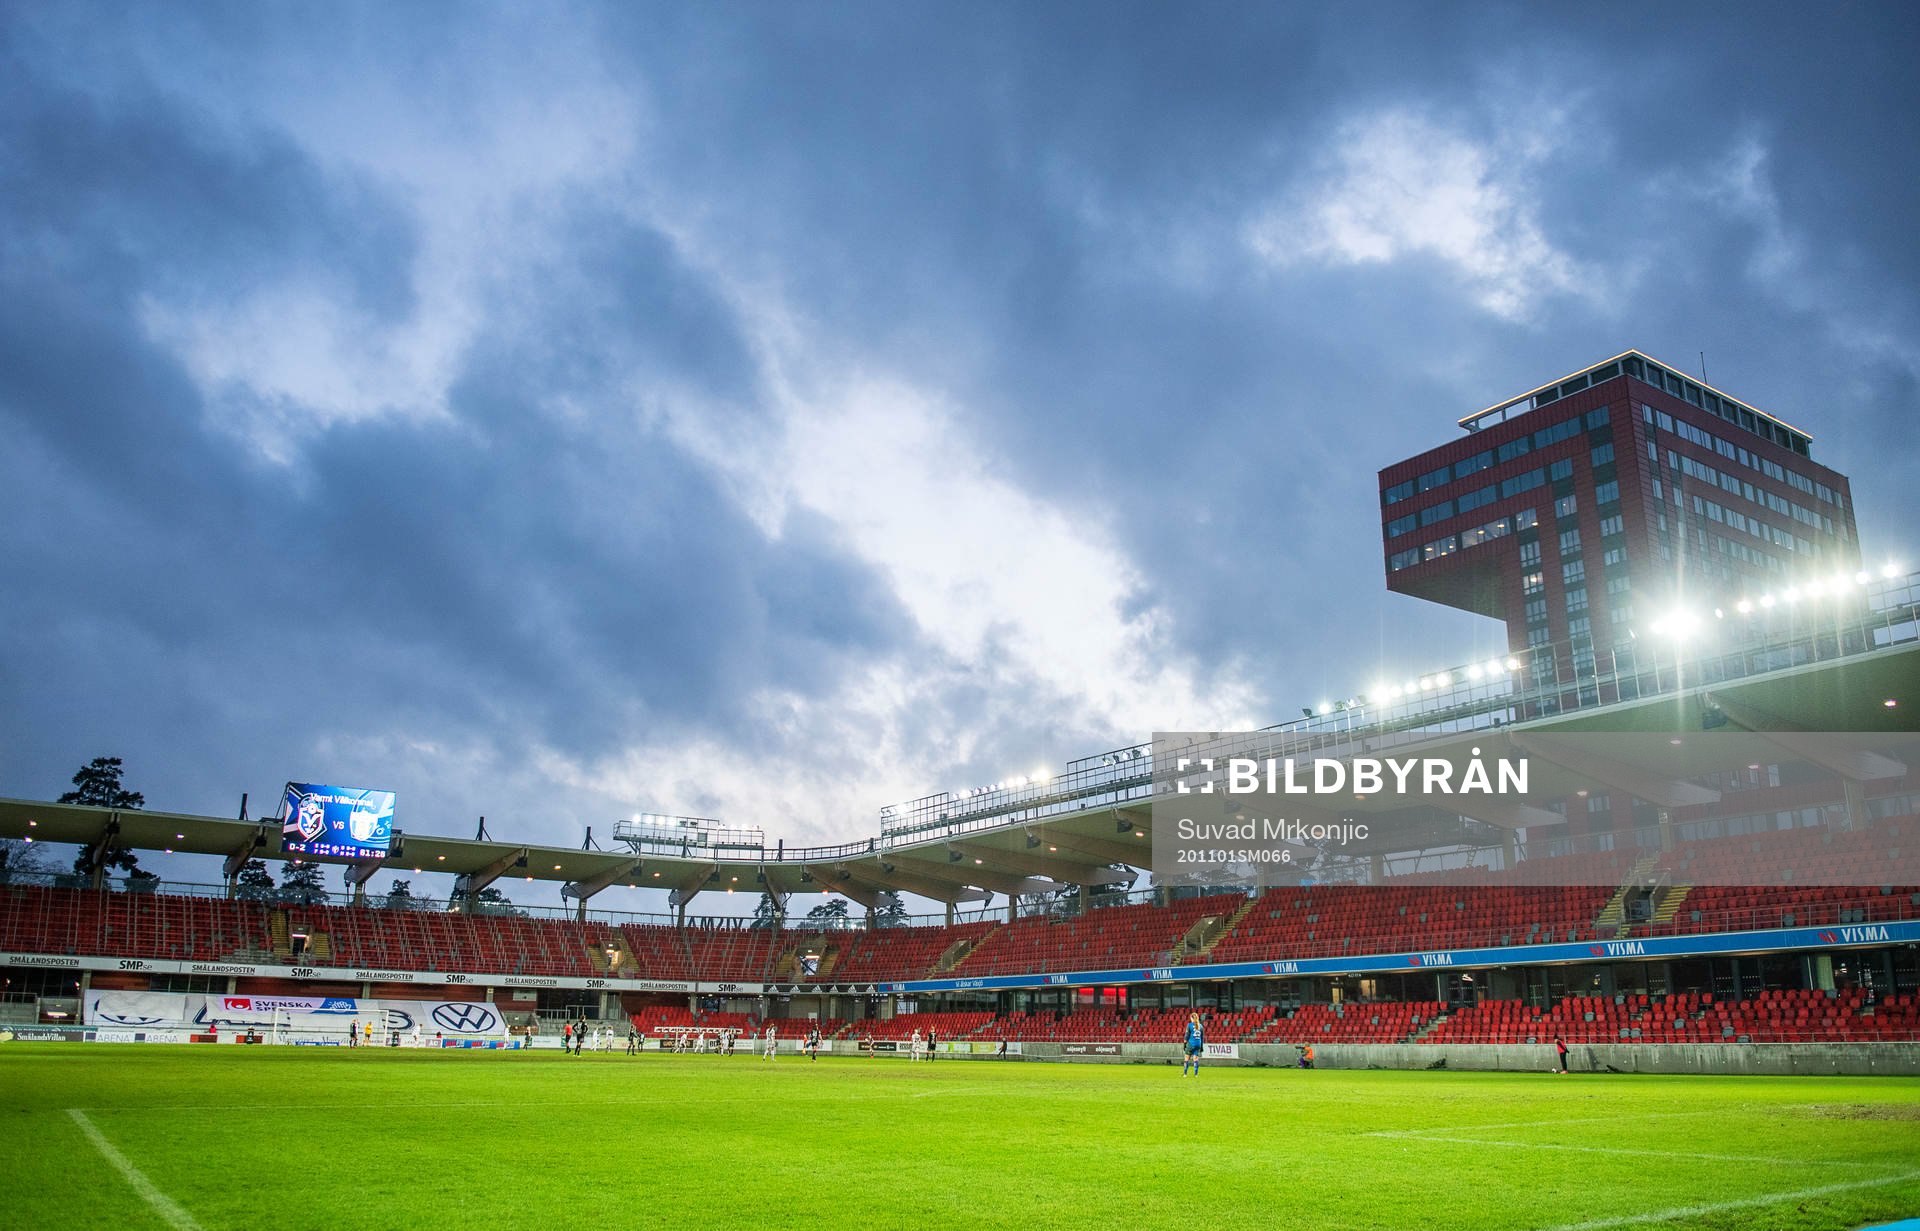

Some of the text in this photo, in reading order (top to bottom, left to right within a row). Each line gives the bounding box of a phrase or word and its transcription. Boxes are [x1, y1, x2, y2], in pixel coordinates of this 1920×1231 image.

[1842, 926, 1890, 942] VISMA
[1608, 942, 1645, 956] VISMA
[9, 955, 80, 967] SMÅLANDSPOSTEN
[1423, 953, 1452, 966] VISMA
[192, 963, 256, 975] SMÅLANDSPOSTEN
[1274, 962, 1298, 973] VISMA
[356, 970, 414, 981] SMÅLANDSPOSTEN
[1051, 974, 1068, 984] VISMA
[1152, 969, 1173, 980] VISMA
[504, 977, 557, 987] SMÅLANDSPOSTEN
[640, 981, 688, 991] SMÅLANDSPOSTEN
[255, 1000, 313, 1008] SVENSKA
[1208, 1045, 1232, 1054] TIVAB
